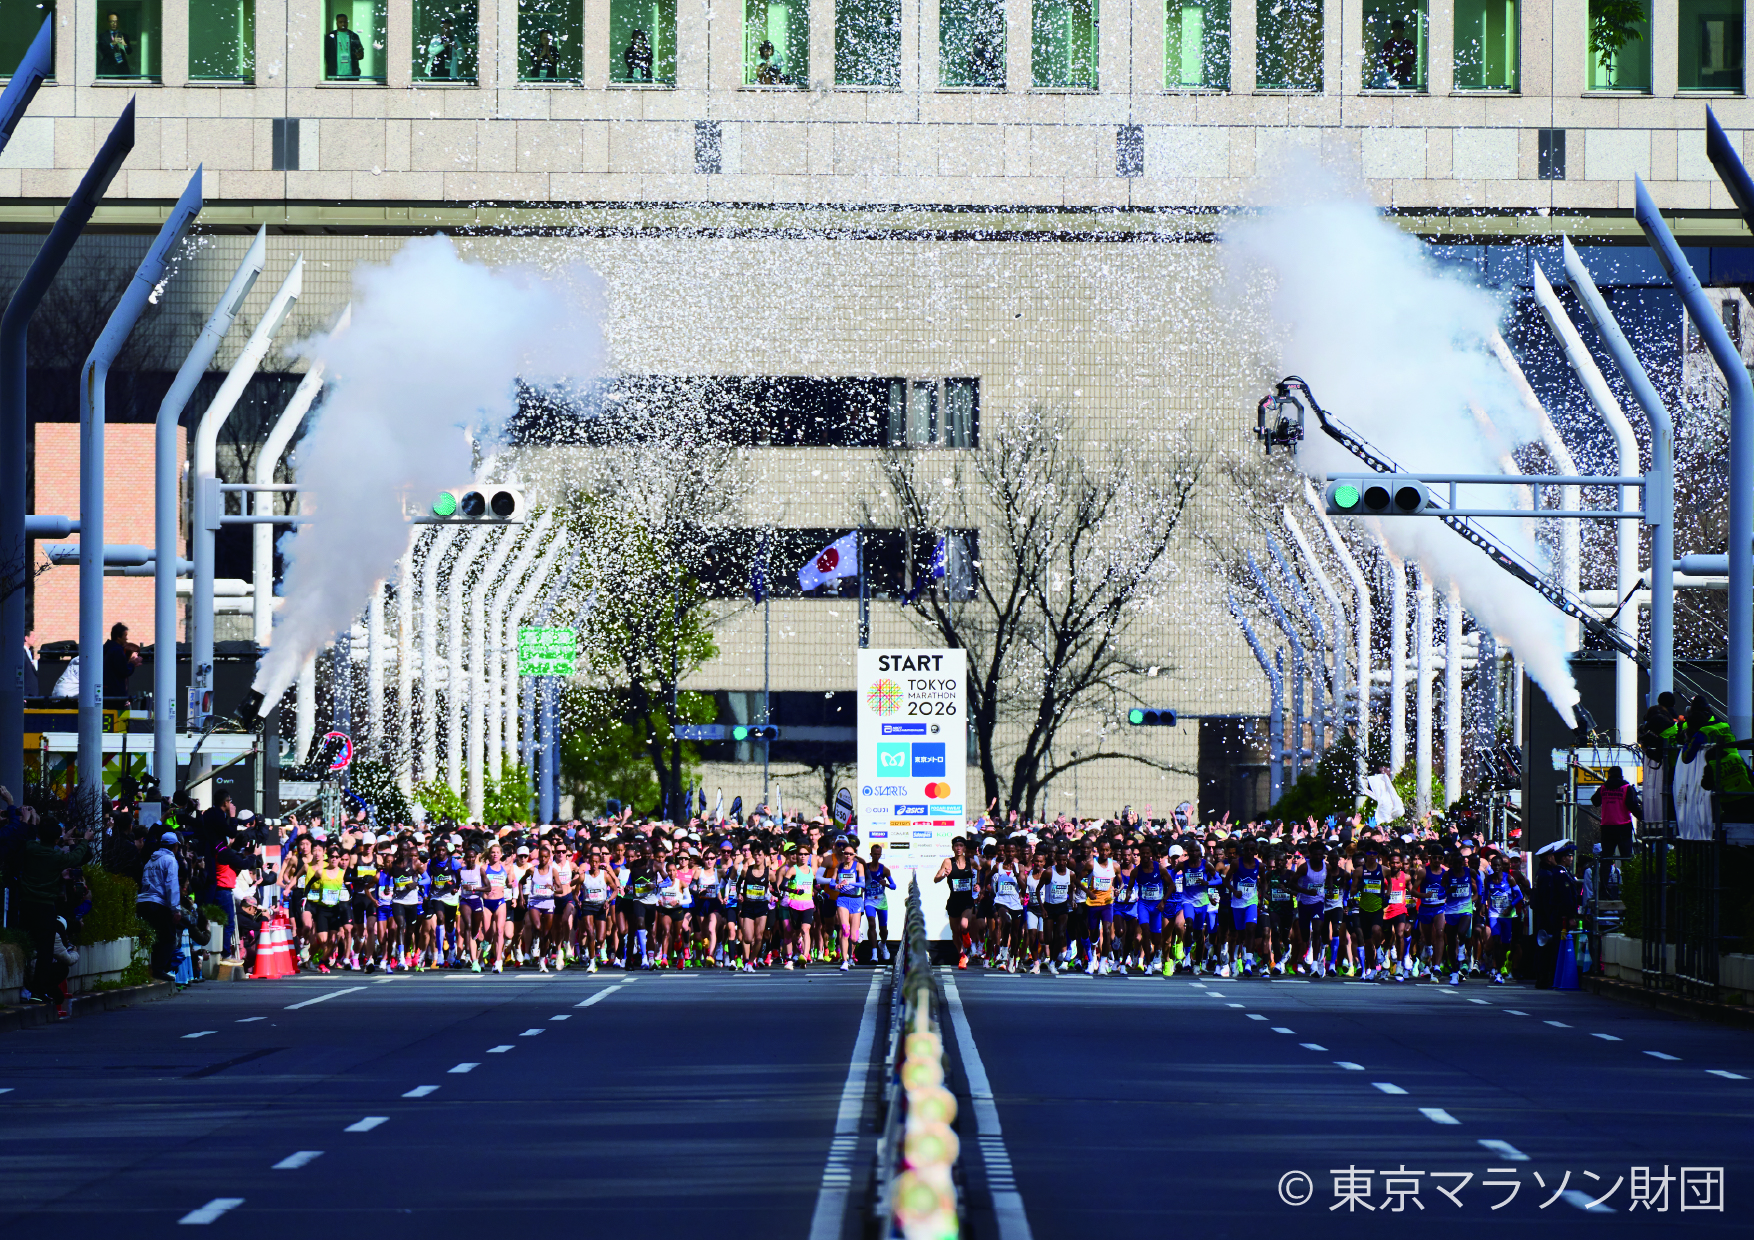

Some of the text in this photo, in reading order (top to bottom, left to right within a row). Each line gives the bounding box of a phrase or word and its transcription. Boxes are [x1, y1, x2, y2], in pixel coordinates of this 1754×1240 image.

[878, 655, 943, 671] START
[908, 679, 956, 690] TOKYO
[908, 702, 956, 715] 2026
